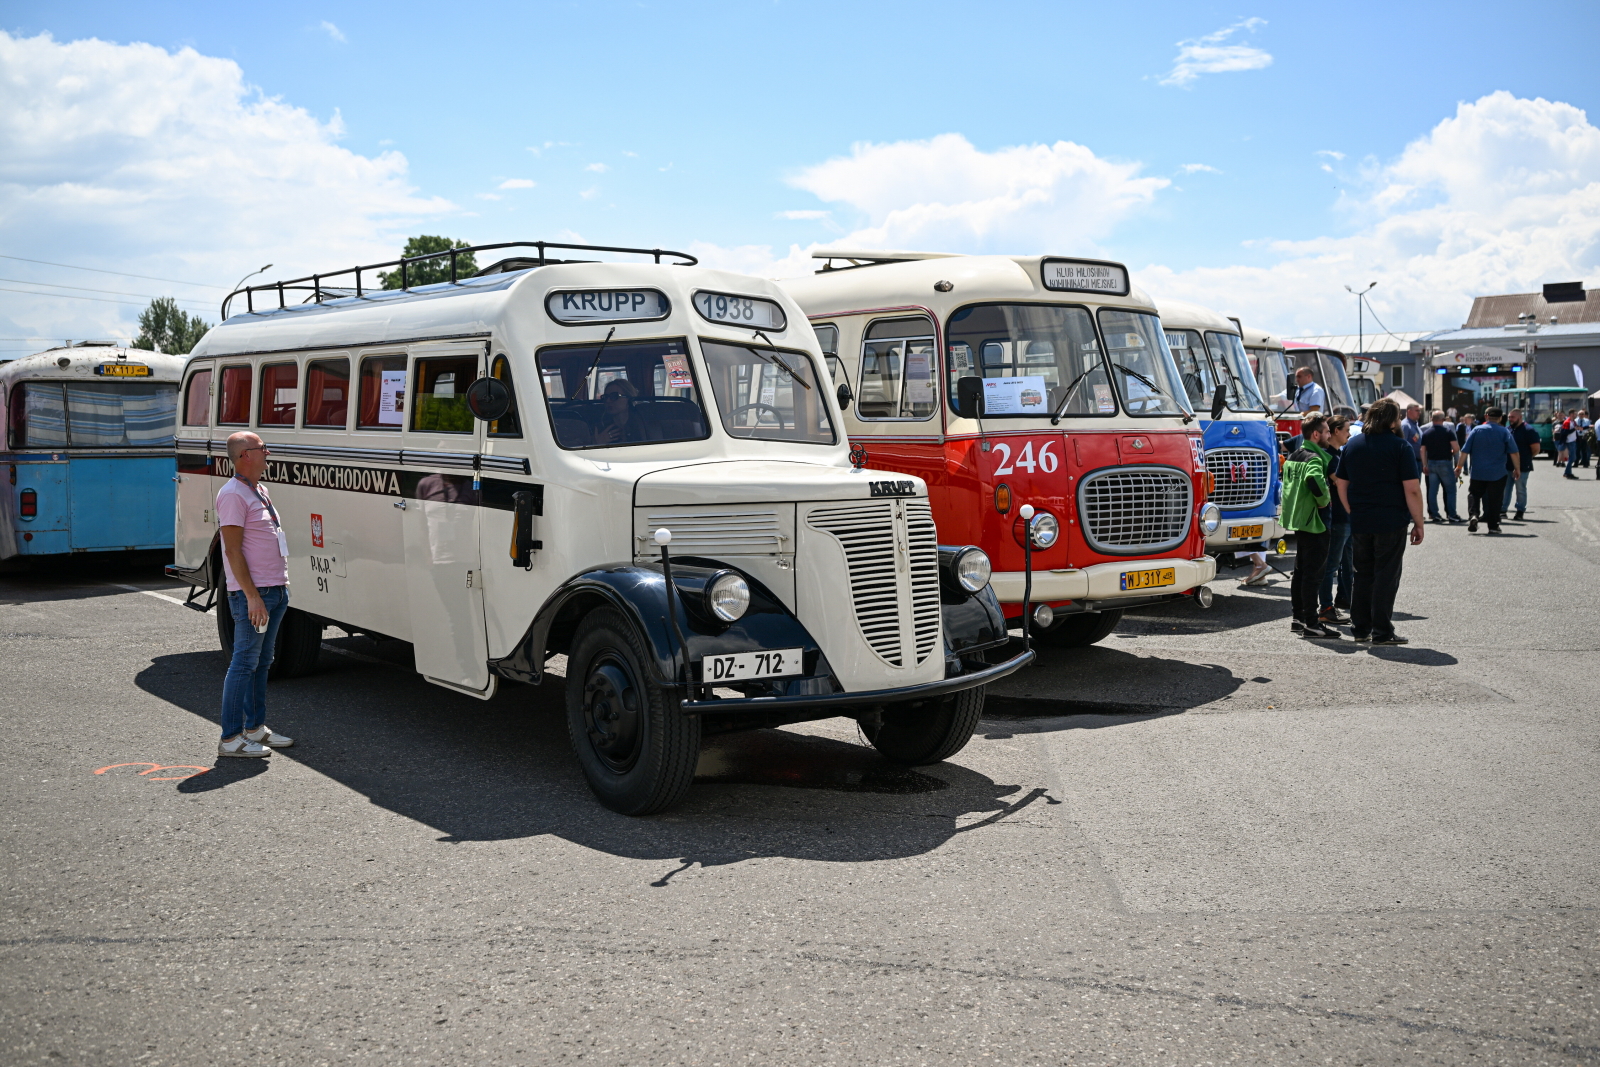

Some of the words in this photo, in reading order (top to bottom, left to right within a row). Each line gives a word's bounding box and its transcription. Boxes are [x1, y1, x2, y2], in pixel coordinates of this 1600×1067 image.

[1056, 267, 1073, 278] KLUB
[562, 292, 646, 312] KRUPP
[703, 294, 754, 320] 1938
[105, 365, 116, 374] WX
[991, 440, 1058, 476] 246
[293, 463, 402, 495] SAMOCHODOWA
[310, 555, 331, 574] P.K.P.
[317, 576, 328, 593] 91
[1127, 571, 1140, 588] WJ
[1144, 570, 1161, 586] 31Y
[755, 653, 782, 675] 712
